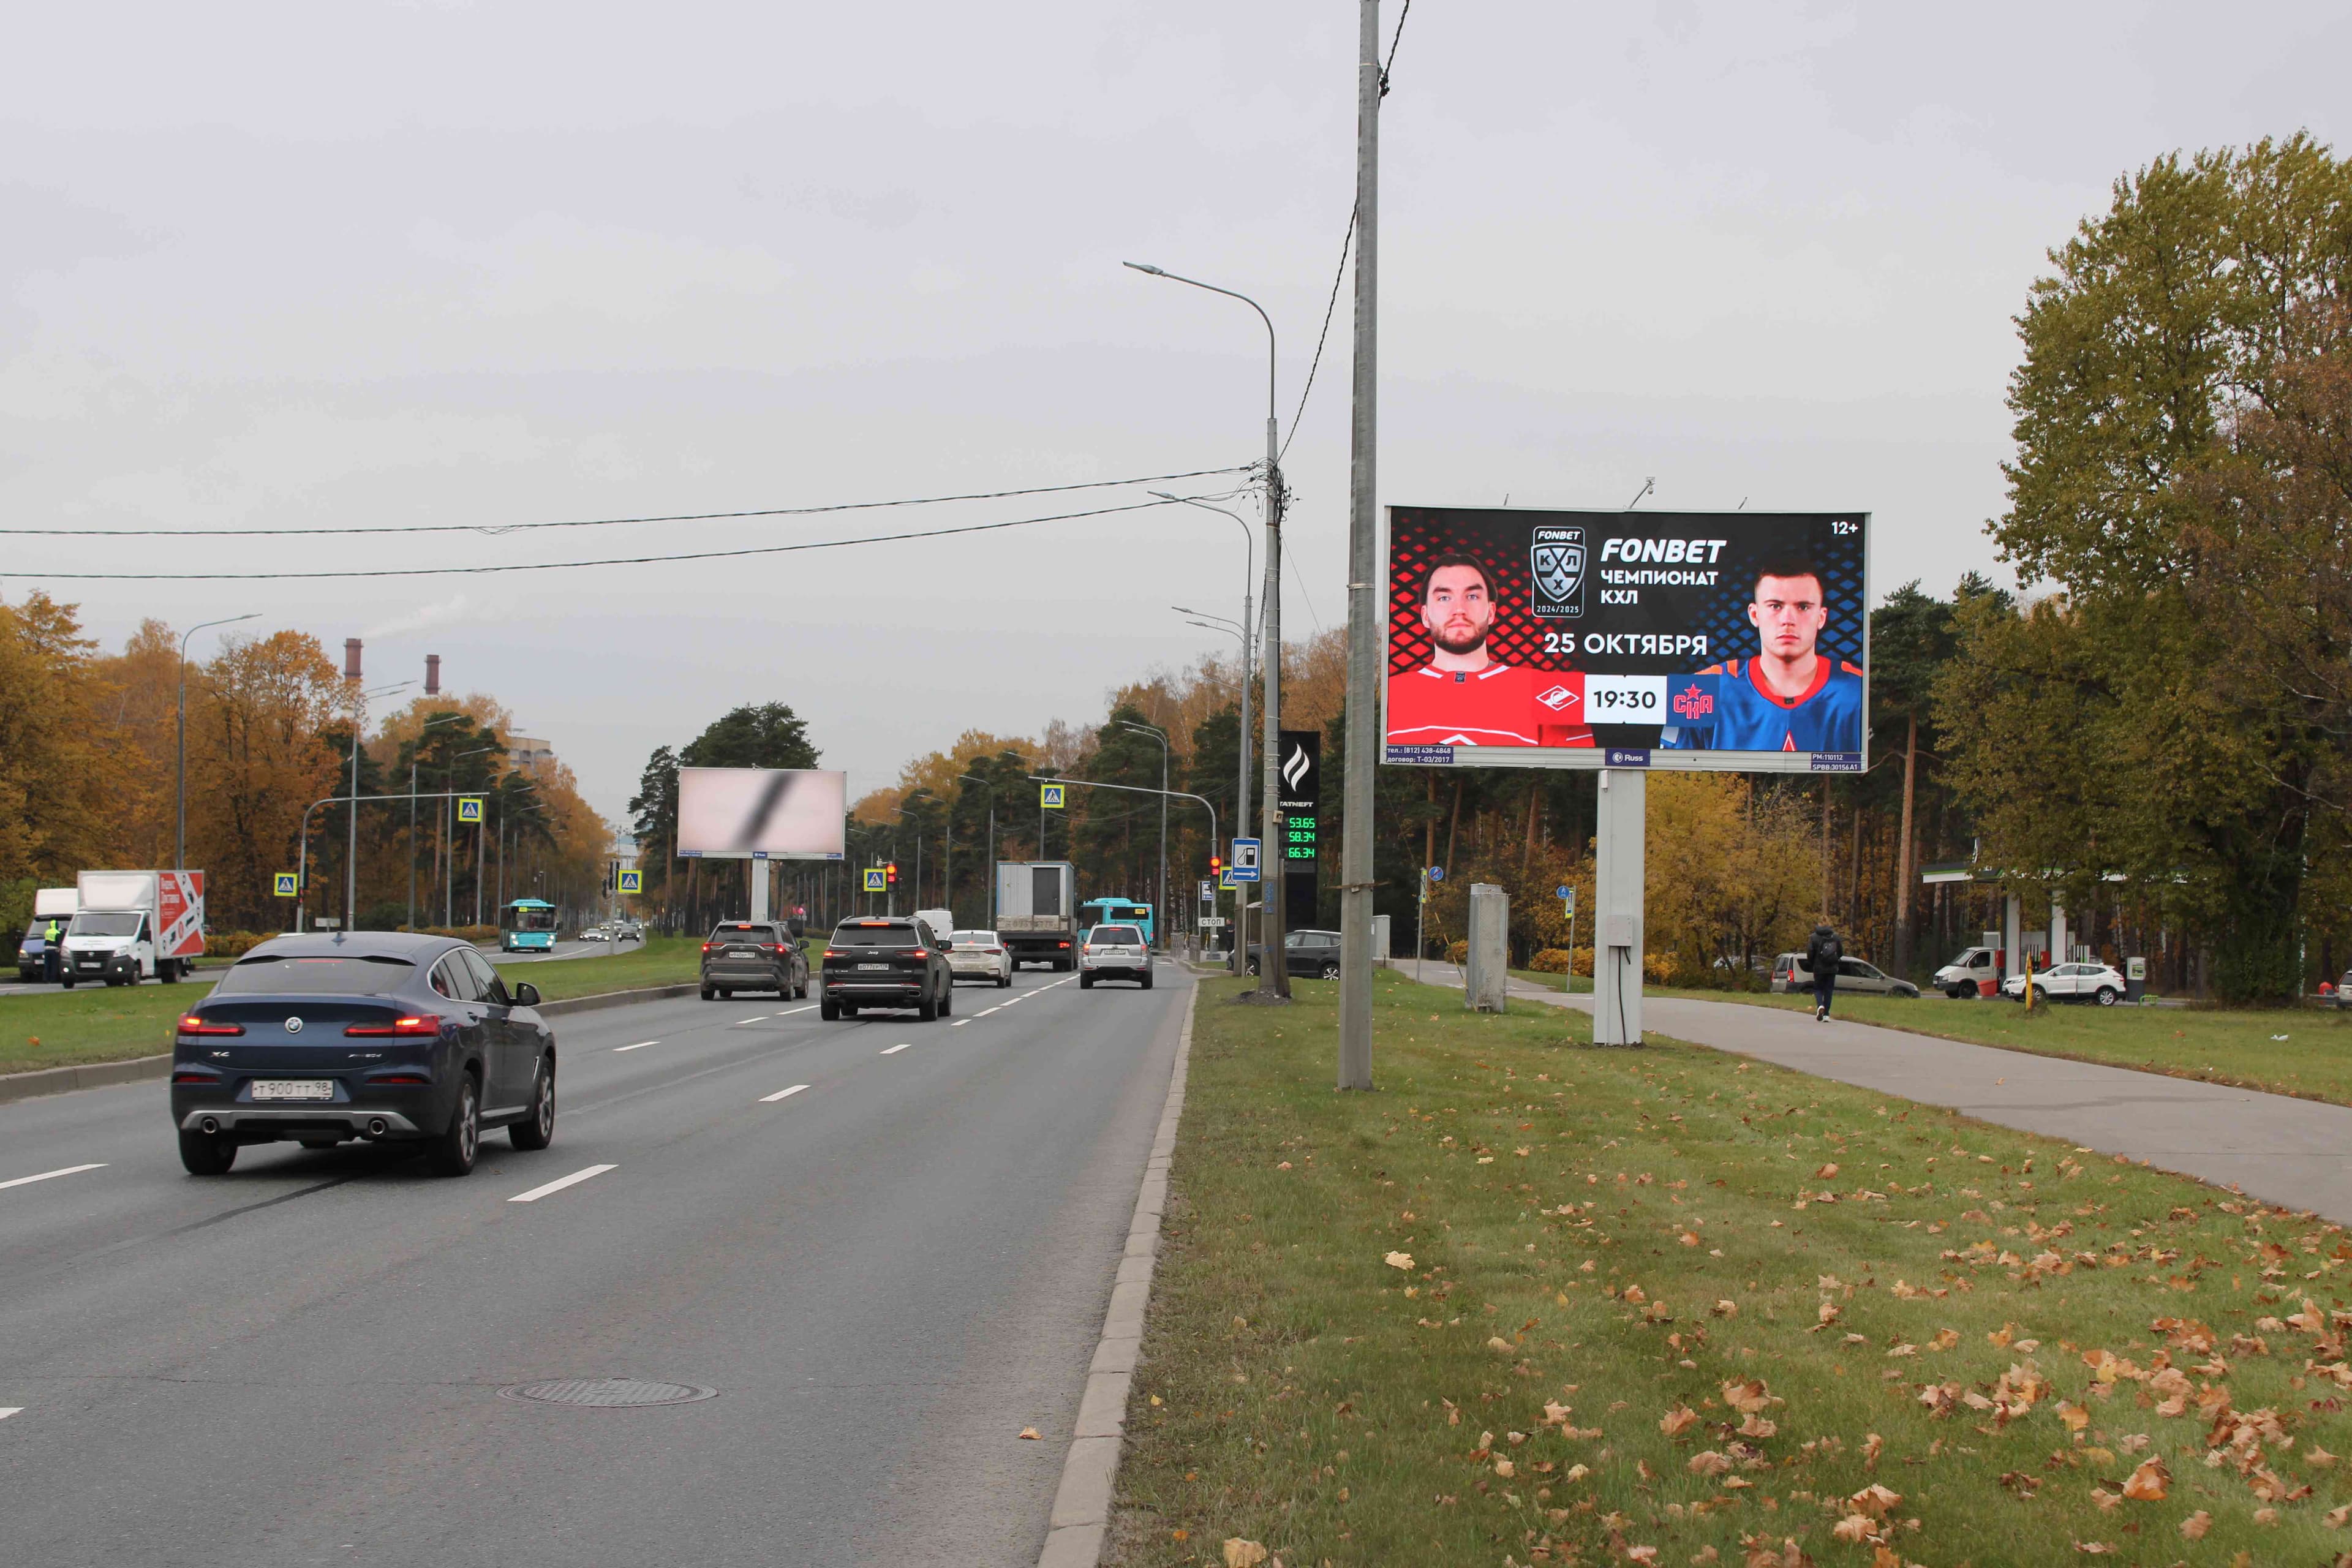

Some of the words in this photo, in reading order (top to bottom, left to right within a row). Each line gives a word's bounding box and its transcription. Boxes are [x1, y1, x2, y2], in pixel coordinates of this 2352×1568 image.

[1537, 531, 1581, 540] FONBET
[1831, 521, 1858, 535] 12+
[1600, 538, 1727, 564] FONBET
[1600, 570, 1719, 586] ЧЕМПИОНАТ
[1600, 590, 1638, 605] КХЛ
[1544, 633, 1575, 654] 25
[1584, 633, 1707, 655] ОКТЯБРЯ
[1594, 690, 1656, 709] 19:30
[1673, 694, 1714, 720] СКА
[1289, 818, 1316, 828] 53.65
[1289, 832, 1315, 842] 58.34
[1288, 847, 1314, 858] 66.34
